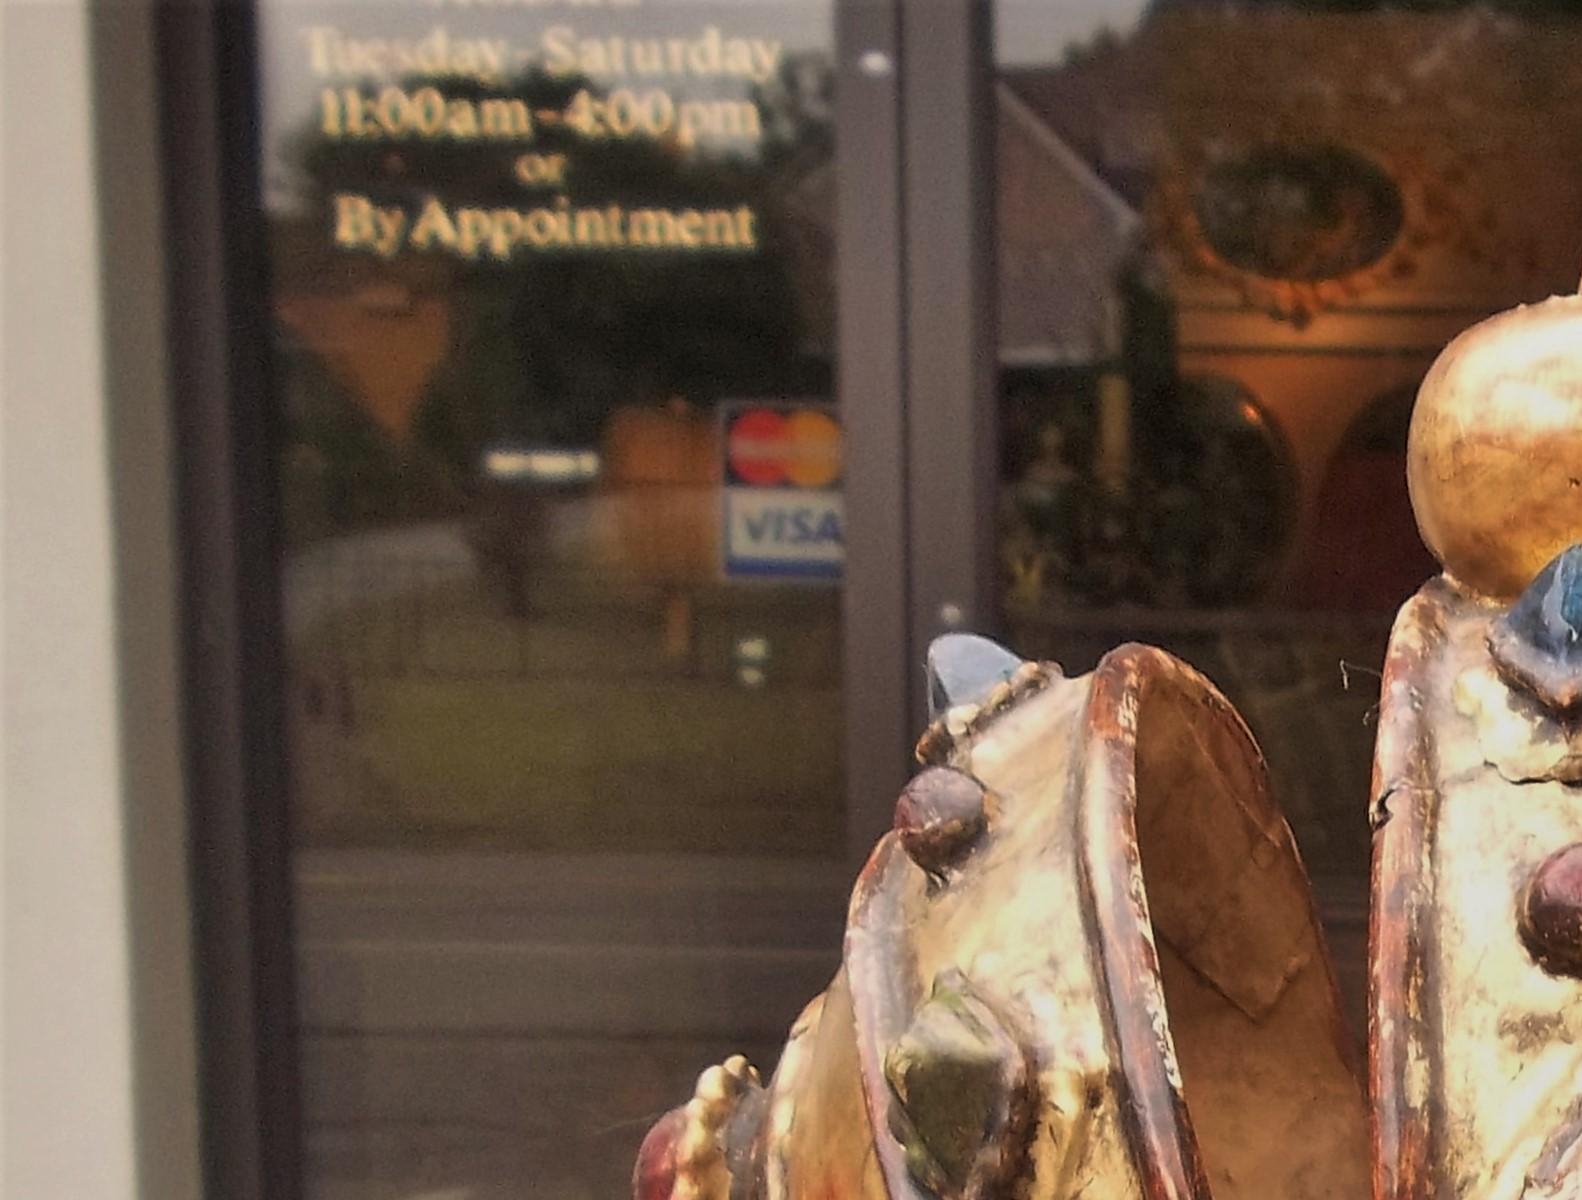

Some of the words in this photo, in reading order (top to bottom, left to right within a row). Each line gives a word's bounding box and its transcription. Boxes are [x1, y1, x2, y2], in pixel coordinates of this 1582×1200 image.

[311, 26, 502, 84] Tuesday
[544, 26, 781, 81] Saturday
[517, 156, 566, 184] or
[336, 195, 402, 252] By
[411, 196, 756, 260] Appointment
[745, 509, 844, 544] VISA
